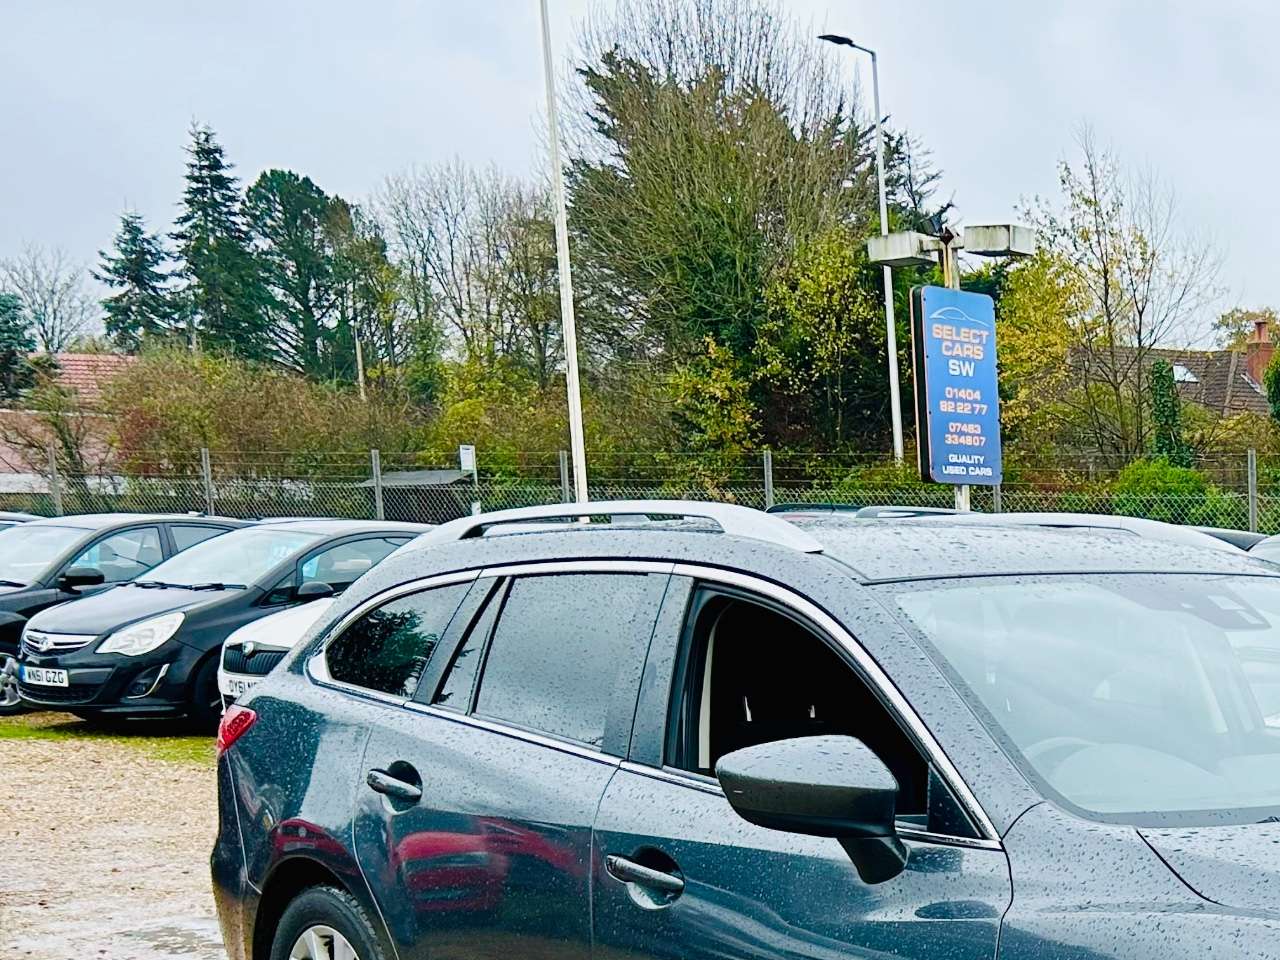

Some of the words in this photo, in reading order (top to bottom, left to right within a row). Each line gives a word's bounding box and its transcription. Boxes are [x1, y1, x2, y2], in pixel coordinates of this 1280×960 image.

[932, 324, 990, 344] SELECT
[942, 341, 984, 360] CARS
[949, 360, 975, 377] SW
[945, 387, 981, 400] 01404
[940, 401, 955, 412] 82
[956, 402, 972, 414] 22
[973, 404, 988, 416] 77
[949, 454, 985, 464] QUALITY
[942, 465, 966, 475] USED
[968, 466, 993, 476] CARS
